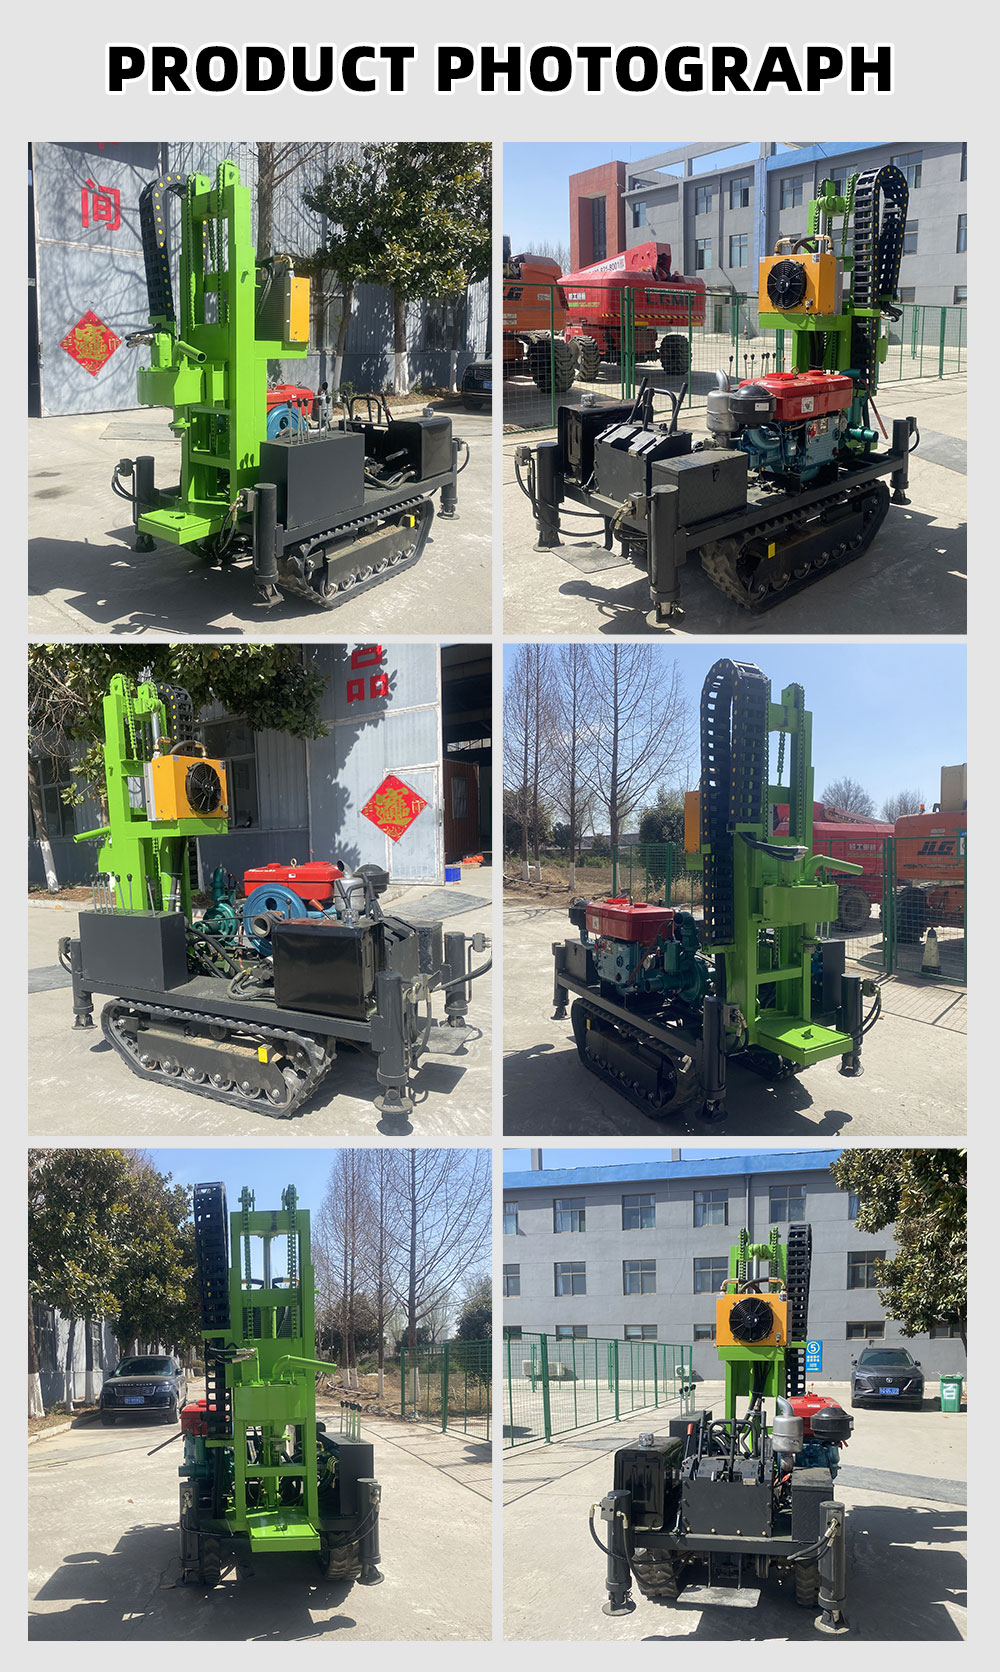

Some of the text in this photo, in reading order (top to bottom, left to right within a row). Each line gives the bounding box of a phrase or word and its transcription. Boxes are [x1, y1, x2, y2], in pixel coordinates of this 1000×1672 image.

[81, 178, 121, 231] 间
[346, 645, 389, 703] 品
[917, 841, 955, 855] JLG
